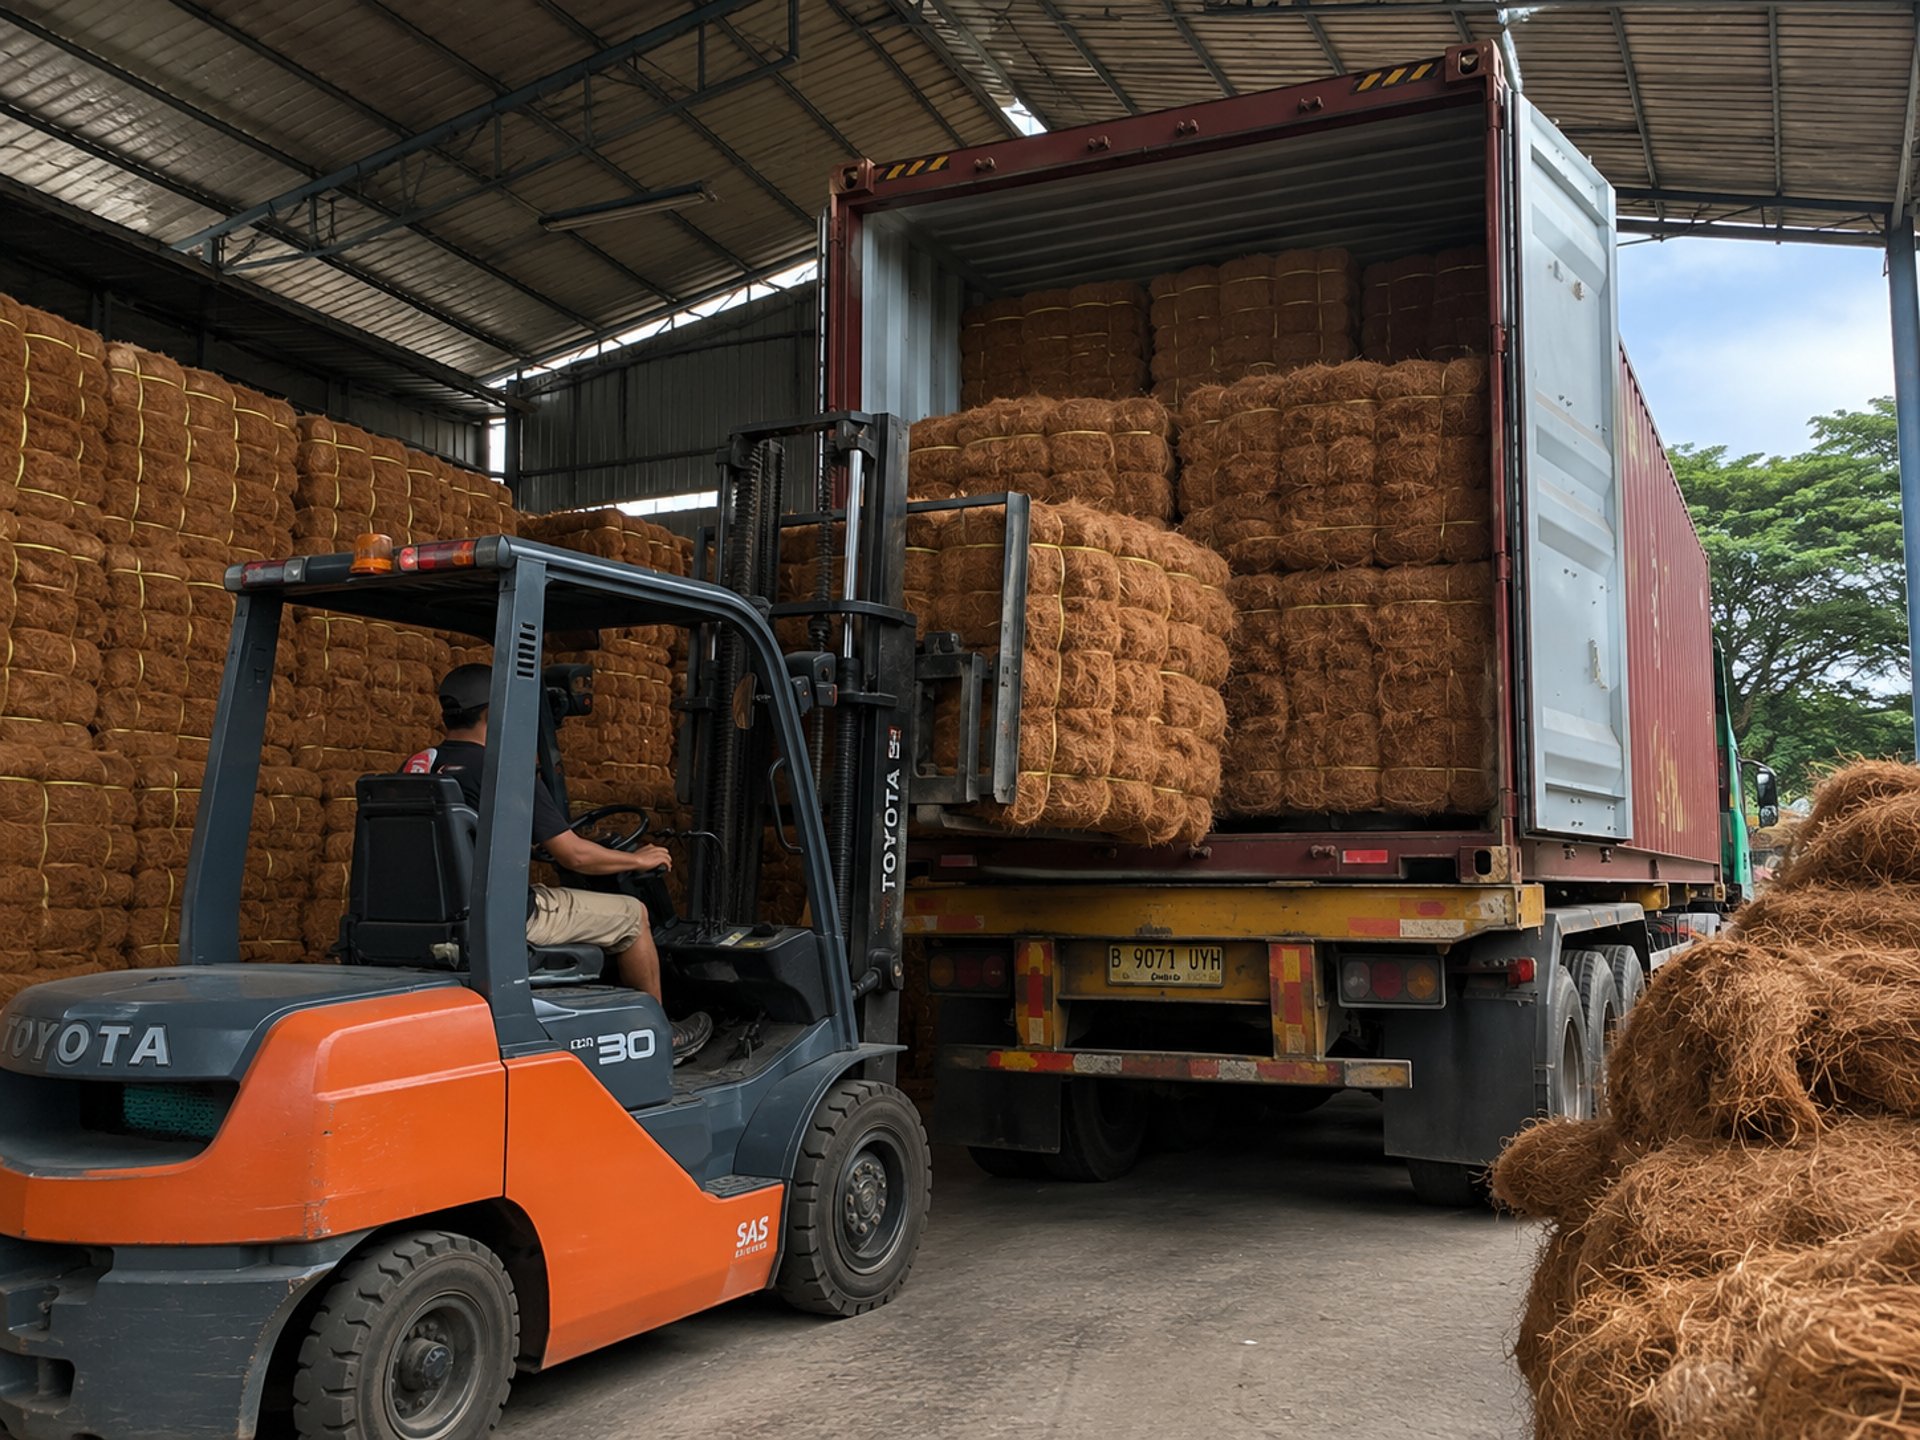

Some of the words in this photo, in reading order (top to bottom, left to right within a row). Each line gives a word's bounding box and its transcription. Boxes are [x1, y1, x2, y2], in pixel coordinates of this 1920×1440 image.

[882, 769, 900, 892] TOYOTA
[1111, 947, 1122, 969] B
[1134, 948, 1175, 969] 9071
[1189, 948, 1221, 970] UYH
[3, 1016, 170, 1066] TOYOTA
[598, 1029, 656, 1065] 30
[736, 1215, 769, 1249] SAS
